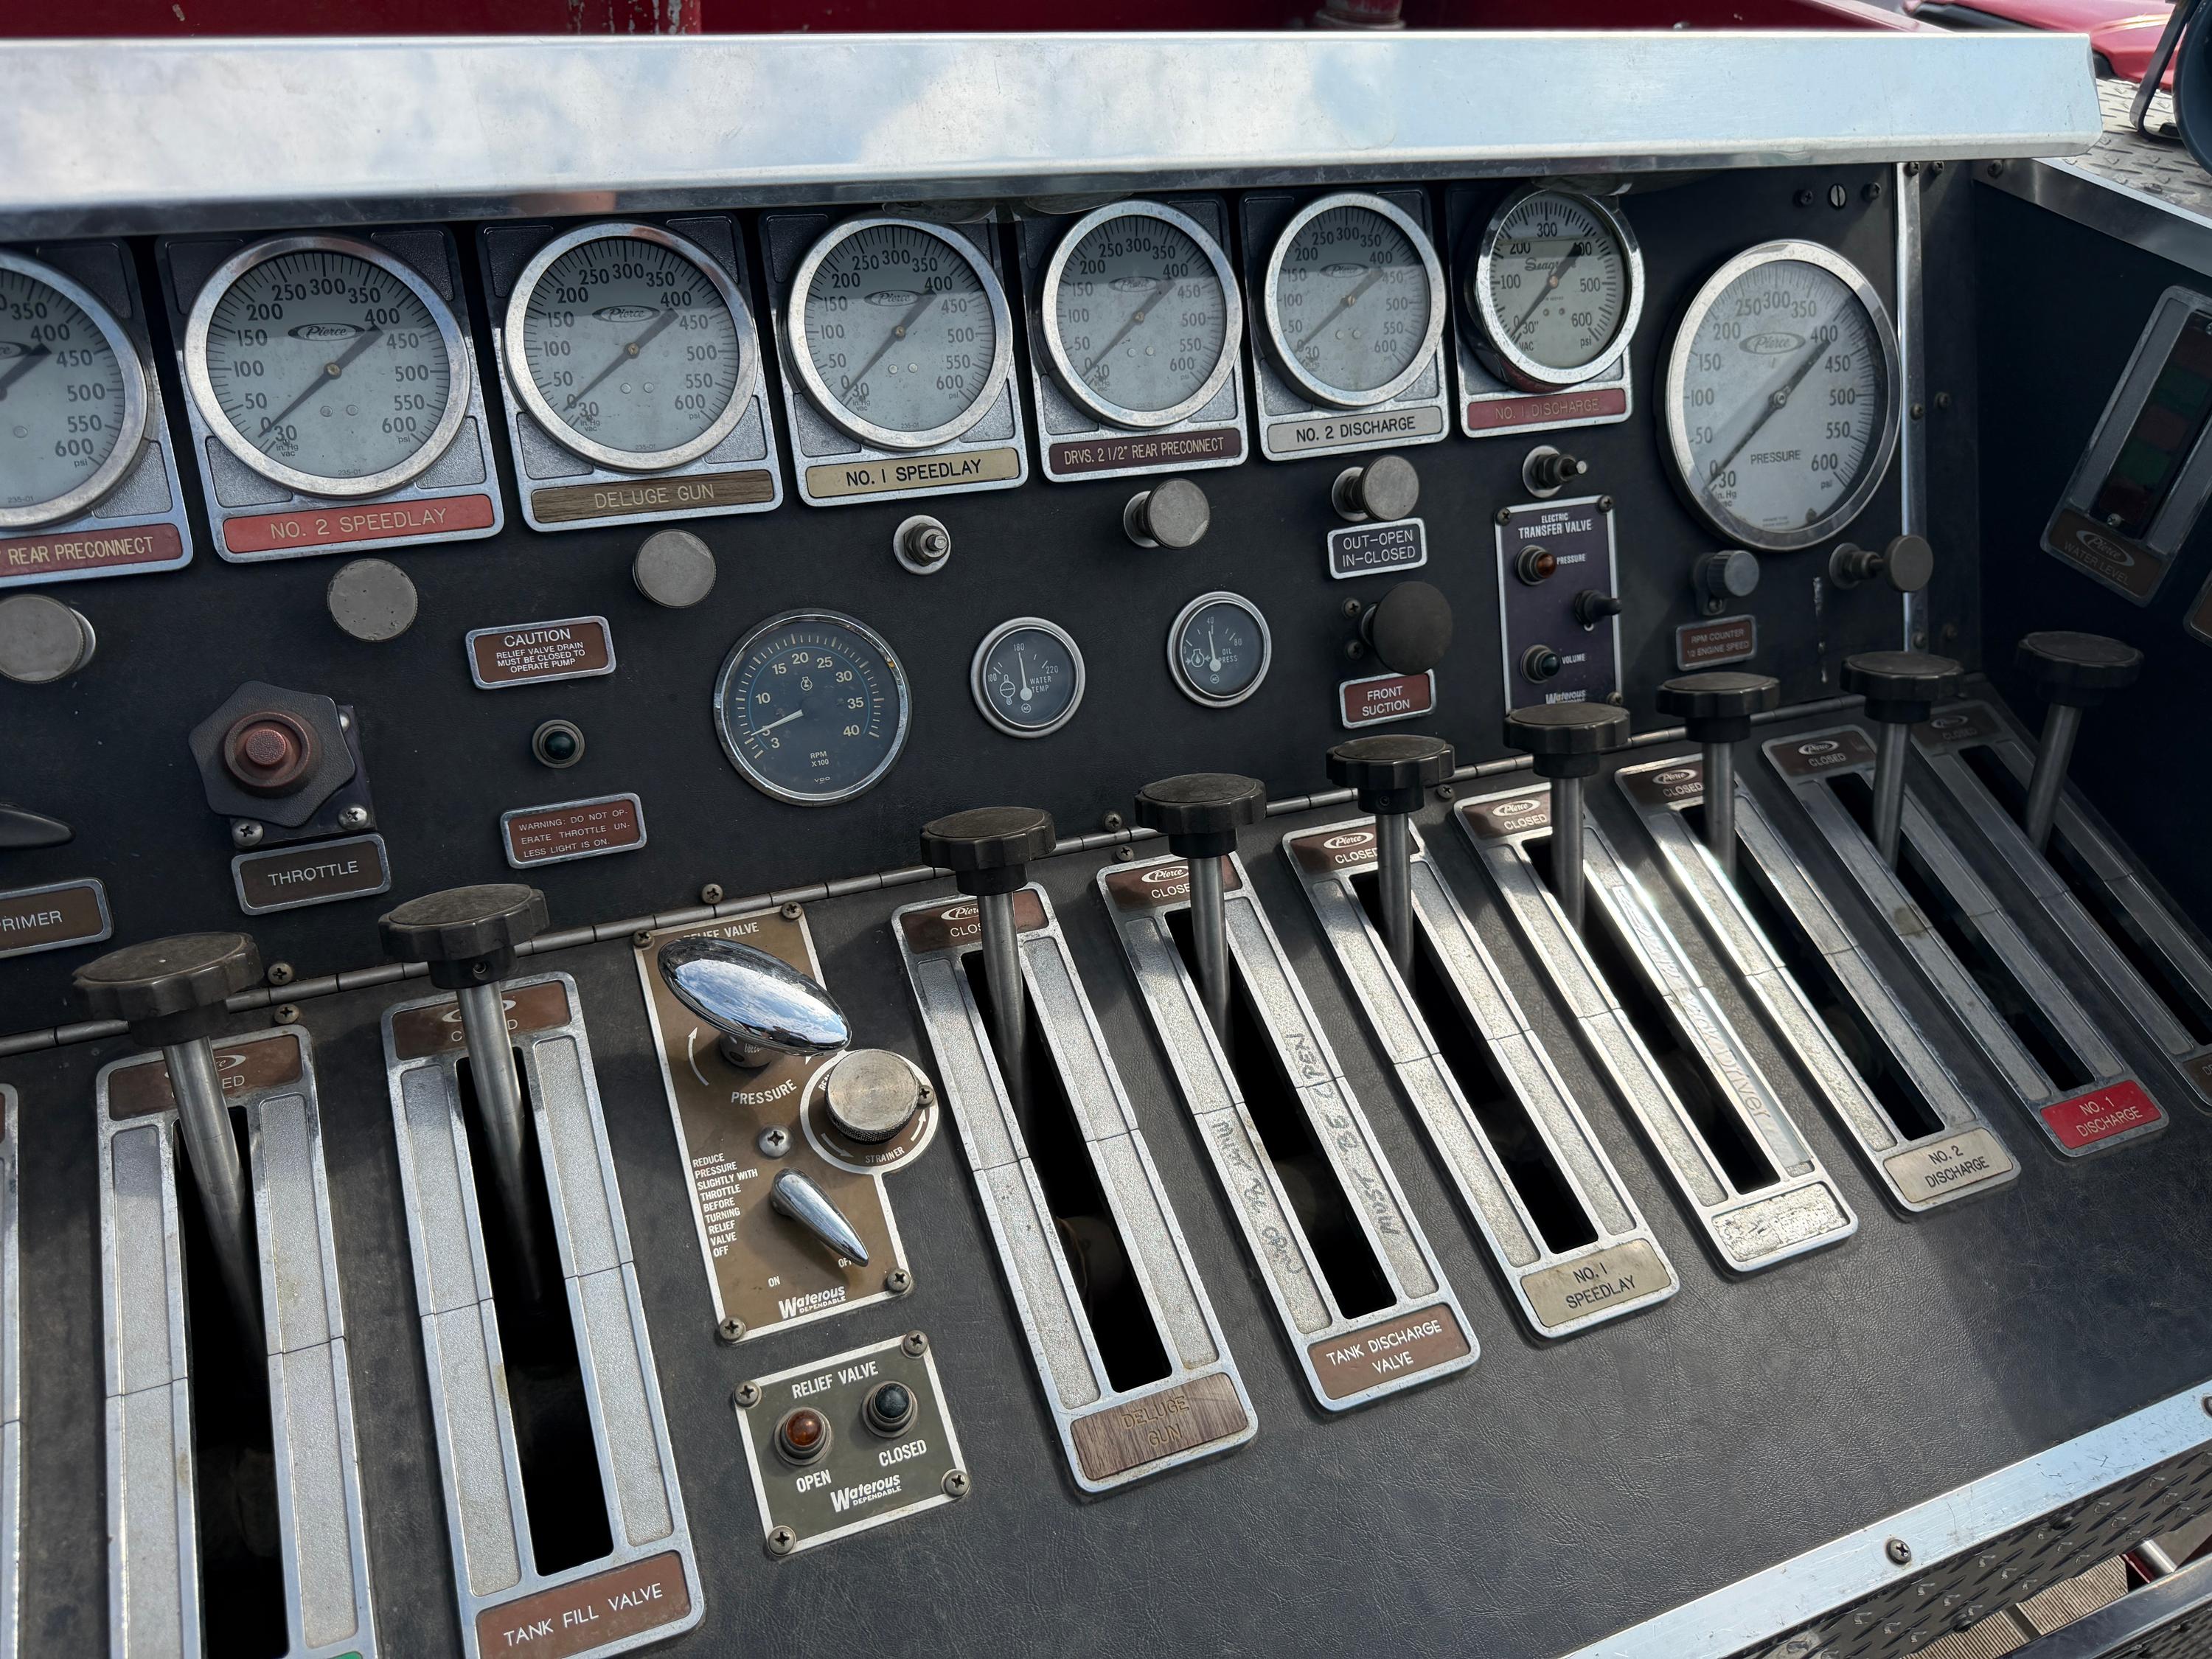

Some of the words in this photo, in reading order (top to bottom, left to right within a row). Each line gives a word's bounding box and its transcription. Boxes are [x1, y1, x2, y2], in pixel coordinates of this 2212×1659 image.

[1337, 227, 1360, 242] 300
[1537, 222, 1557, 238] 300
[883, 250, 911, 265] 300
[612, 263, 644, 279] 300
[310, 279, 346, 296] 300
[1580, 277, 1601, 293] 500
[1763, 291, 1790, 309] 300
[1181, 313, 1206, 327] 500
[30, 324, 71, 341] 400
[305, 325, 349, 339] Pierce
[686, 345, 717, 361] 500
[1519, 341, 1534, 352] VAC
[936, 375, 964, 390] 600
[66, 383, 106, 402] 500
[1829, 388, 1856, 406] 500
[1495, 408, 1516, 420] NO.
[1532, 398, 1600, 417] DISCHARGE
[382, 417, 417, 434] 600
[1296, 428, 1320, 443] NO.
[1325, 426, 1335, 439] 2
[1340, 416, 1416, 439] DISCHARGE
[1064, 449, 1095, 465] DRVS.
[1097, 448, 1105, 462] 2
[1132, 442, 1158, 458] REAR
[1161, 437, 1225, 456] PRECONNECT
[1750, 449, 1801, 465] PRESSURE
[846, 469, 875, 487] NO.
[895, 458, 983, 482] SPEEDLAY
[594, 487, 668, 510] DELUGE
[677, 483, 715, 503] GUN
[270, 521, 307, 540] NO.
[316, 518, 330, 536] 2
[339, 507, 448, 535] SPEEDLAY
[1541, 512, 1569, 524] ELECTRIC
[1518, 522, 1562, 540] TRANSFER
[1565, 519, 1593, 532] VALVE
[1342, 529, 1414, 551] OUT-OPEN
[9, 546, 50, 566] REAR
[55, 536, 154, 562] PRECONNECT
[1342, 546, 1416, 568] IN-CLOSED
[1557, 554, 1586, 566] PRESSURE
[2065, 541, 2100, 570] WATER
[2096, 557, 2129, 587] LEVEL
[504, 627, 571, 647] CAUTION
[496, 648, 526, 659] RELIEF
[527, 645, 556, 656] VALVE
[557, 641, 584, 652] DRAIN
[1014, 642, 1025, 652] 180
[497, 656, 522, 667] MUST
[524, 655, 536, 664] BE
[537, 650, 573, 662] CLOSED
[574, 648, 586, 658] TO
[510, 662, 551, 674] OPERATE
[552, 658, 576, 669] PUMP
[791, 652, 809, 665] 20
[816, 656, 833, 669] 25
[1562, 653, 1585, 665] VOLUME
[772, 662, 787, 675] 15
[835, 670, 853, 683] 30
[1046, 665, 1059, 675] 220
[1029, 675, 1052, 685] WATER
[1032, 685, 1049, 693] TEMP
[755, 692, 771, 705] 10
[1366, 685, 1404, 702] FRONT
[847, 697, 864, 709] 35
[1362, 699, 1411, 717] SUCTION
[843, 724, 860, 737] 40
[771, 737, 780, 748] 3
[810, 751, 827, 760] RPM
[1663, 782, 1705, 798] CLOSED
[518, 818, 566, 832] WARNING:
[570, 815, 585, 825] DO
[588, 812, 608, 821] NOT
[612, 809, 629, 818] OP-
[1503, 813, 1548, 830] CLOSED
[521, 834, 552, 845] ERATE
[558, 825, 607, 838] THROTTLE
[613, 822, 631, 831] UN-
[1335, 835, 1363, 848] Pierce
[524, 848, 546, 858] LESS
[550, 843, 577, 854] LIGHT
[581, 841, 591, 850] IS
[594, 838, 611, 848] ON.
[268, 860, 359, 887] THROTTLE
[1154, 869, 1184, 881] Pierce
[1151, 883, 1191, 899] CLOSE
[0, 910, 63, 932] RIMER
[723, 922, 759, 938] VALVE
[731, 1078, 797, 1105] PRESSURE
[2079, 1100, 2104, 1116] NO.
[2106, 1096, 2115, 1108] 1
[2076, 1105, 2143, 1138] DISCHARGE
[692, 1152, 725, 1168] REDUCE
[865, 1146, 905, 1164] STRAINER
[1927, 1150, 1952, 1166] NO.
[1952, 1144, 1964, 1158] 2
[695, 1161, 738, 1179] PRESSURE
[1924, 1155, 1990, 1189] DISCHARGE
[697, 1174, 735, 1192] SLIGHTLY
[737, 1168, 759, 1182] WITH
[700, 1183, 742, 1202] THROTTLE
[703, 1197, 736, 1213] BEFORE
[705, 1207, 741, 1224] TURNING
[708, 1220, 737, 1235] RELIEF
[710, 1232, 737, 1247] VALVE
[713, 1245, 729, 1258] OFF
[768, 1276, 781, 1287] ON
[1573, 1266, 1600, 1284] NO.
[1565, 1274, 1636, 1310] SPEEDLAY
[779, 1286, 846, 1320] Waterous
[799, 1295, 846, 1315] DEPENDABLE
[1326, 1342, 1366, 1367] TANK
[1367, 1318, 1443, 1354] DISCHARGE
[1371, 1351, 1415, 1375] VALVE
[791, 1373, 833, 1399] RELIEF
[838, 1360, 879, 1385] VALVE
[1121, 1395, 1191, 1430] DELUGE
[1147, 1422, 1183, 1448] GUN
[878, 1439, 928, 1467] CLOSED
[796, 1469, 832, 1494] OPEN
[830, 1474, 901, 1513] Waterous
[852, 1485, 902, 1506] DEPENDABLE
[503, 1618, 554, 1647] TANK
[562, 1605, 599, 1629] FILL
[608, 1582, 664, 1612] VALVE
